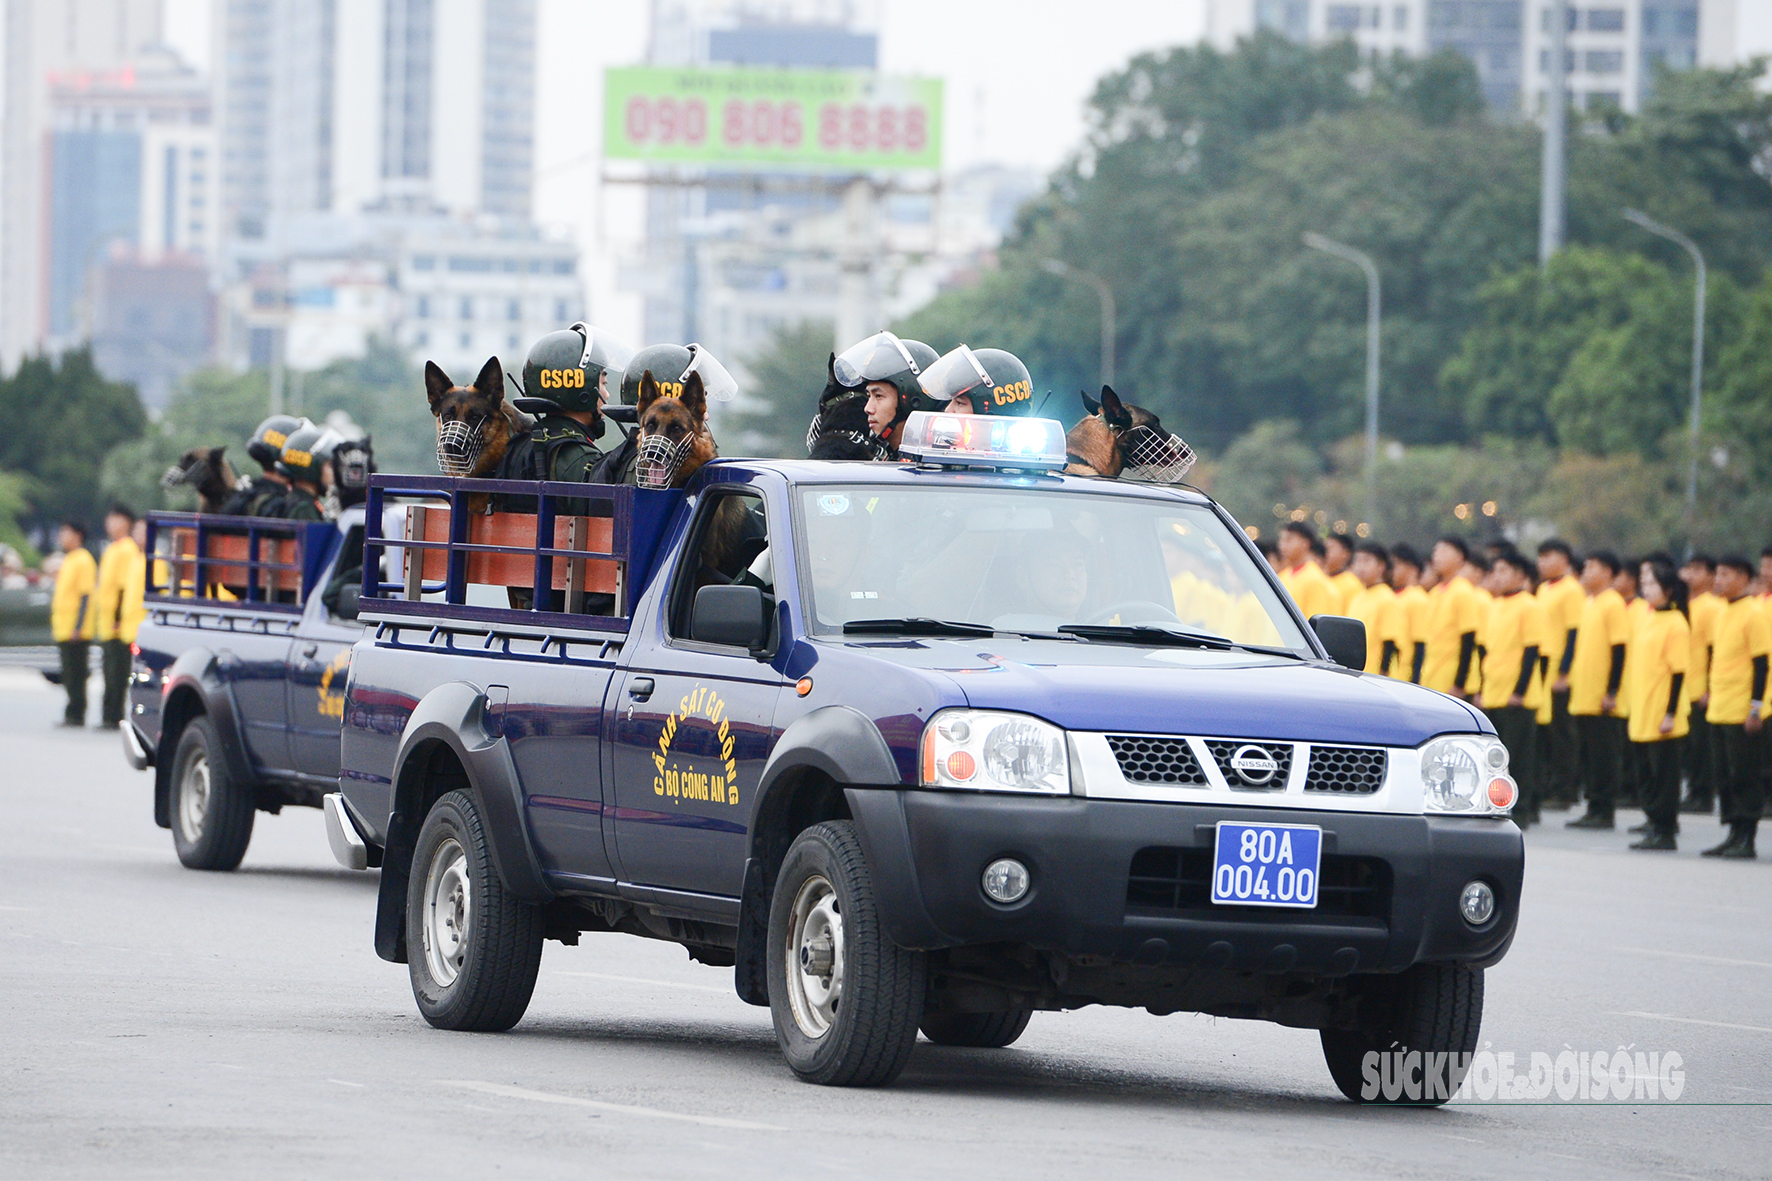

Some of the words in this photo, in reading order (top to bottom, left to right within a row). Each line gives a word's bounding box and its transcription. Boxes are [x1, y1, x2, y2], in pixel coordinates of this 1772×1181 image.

[626, 97, 708, 144] 090
[723, 98, 804, 148] 806
[820, 104, 926, 151] 8888
[540, 368, 585, 388] CSCĐ
[652, 710, 677, 796] CẢNH
[679, 682, 708, 722] SÁT
[705, 691, 725, 725] CƠ
[717, 716, 739, 805] ĐỘNG
[1237, 760, 1275, 769] NISSAN
[665, 763, 680, 805] BỘ
[681, 765, 709, 801] CÔNG
[710, 775, 725, 803] AN
[1239, 829, 1293, 865] 80A
[1216, 864, 1314, 902] 004.00
